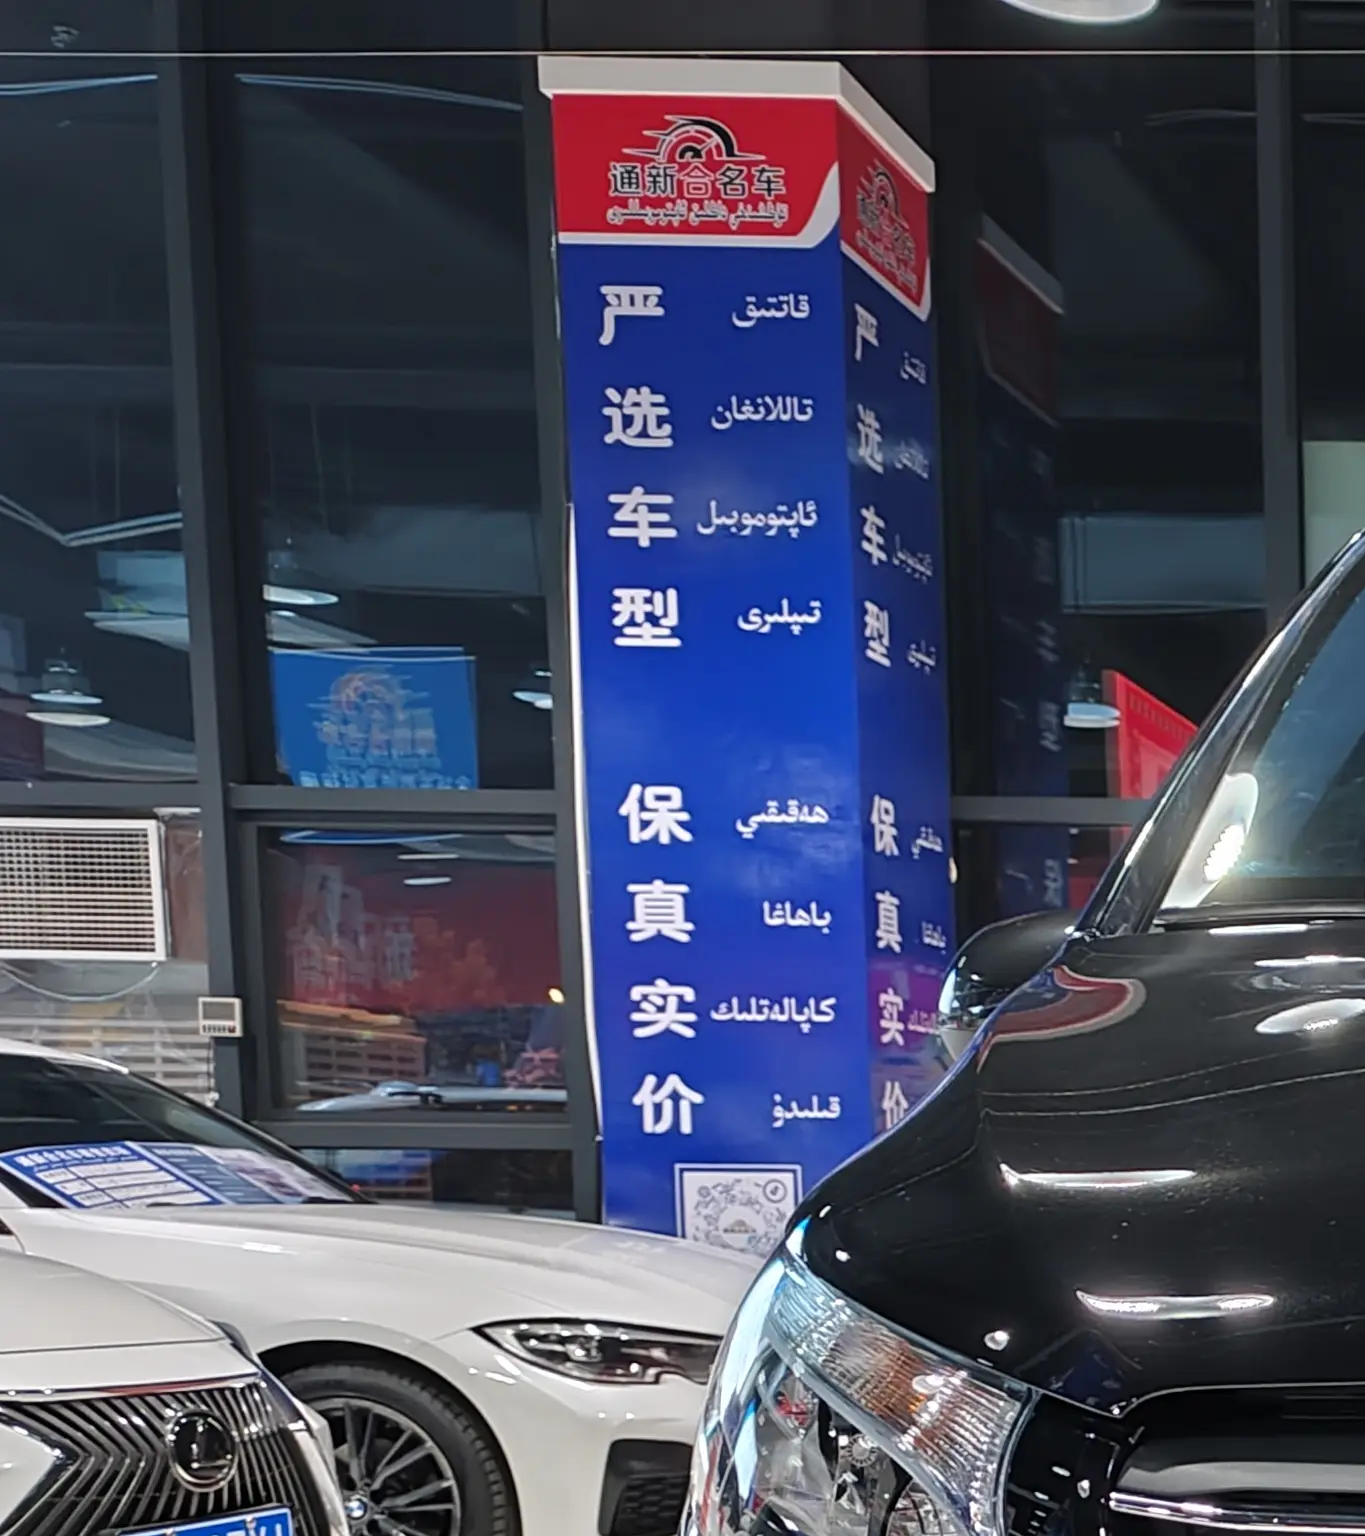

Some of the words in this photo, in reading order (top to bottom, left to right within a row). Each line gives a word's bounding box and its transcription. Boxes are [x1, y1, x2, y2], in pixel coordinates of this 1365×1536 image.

[609, 161, 785, 198] 通新合名车
[732, 293, 810, 328] قاتتىق
[711, 395, 813, 430] تاللانغان
[599, 285, 682, 648] 严选车型
[855, 303, 892, 668] 严选车型
[696, 500, 818, 539] ئاپتوموبىل
[618, 783, 705, 1134] 保真实价
[870, 794, 909, 1130] 保真实价
[709, 996, 837, 1033] كاپالەتلىك
[771, 1093, 841, 1128] قىلىدۇ
